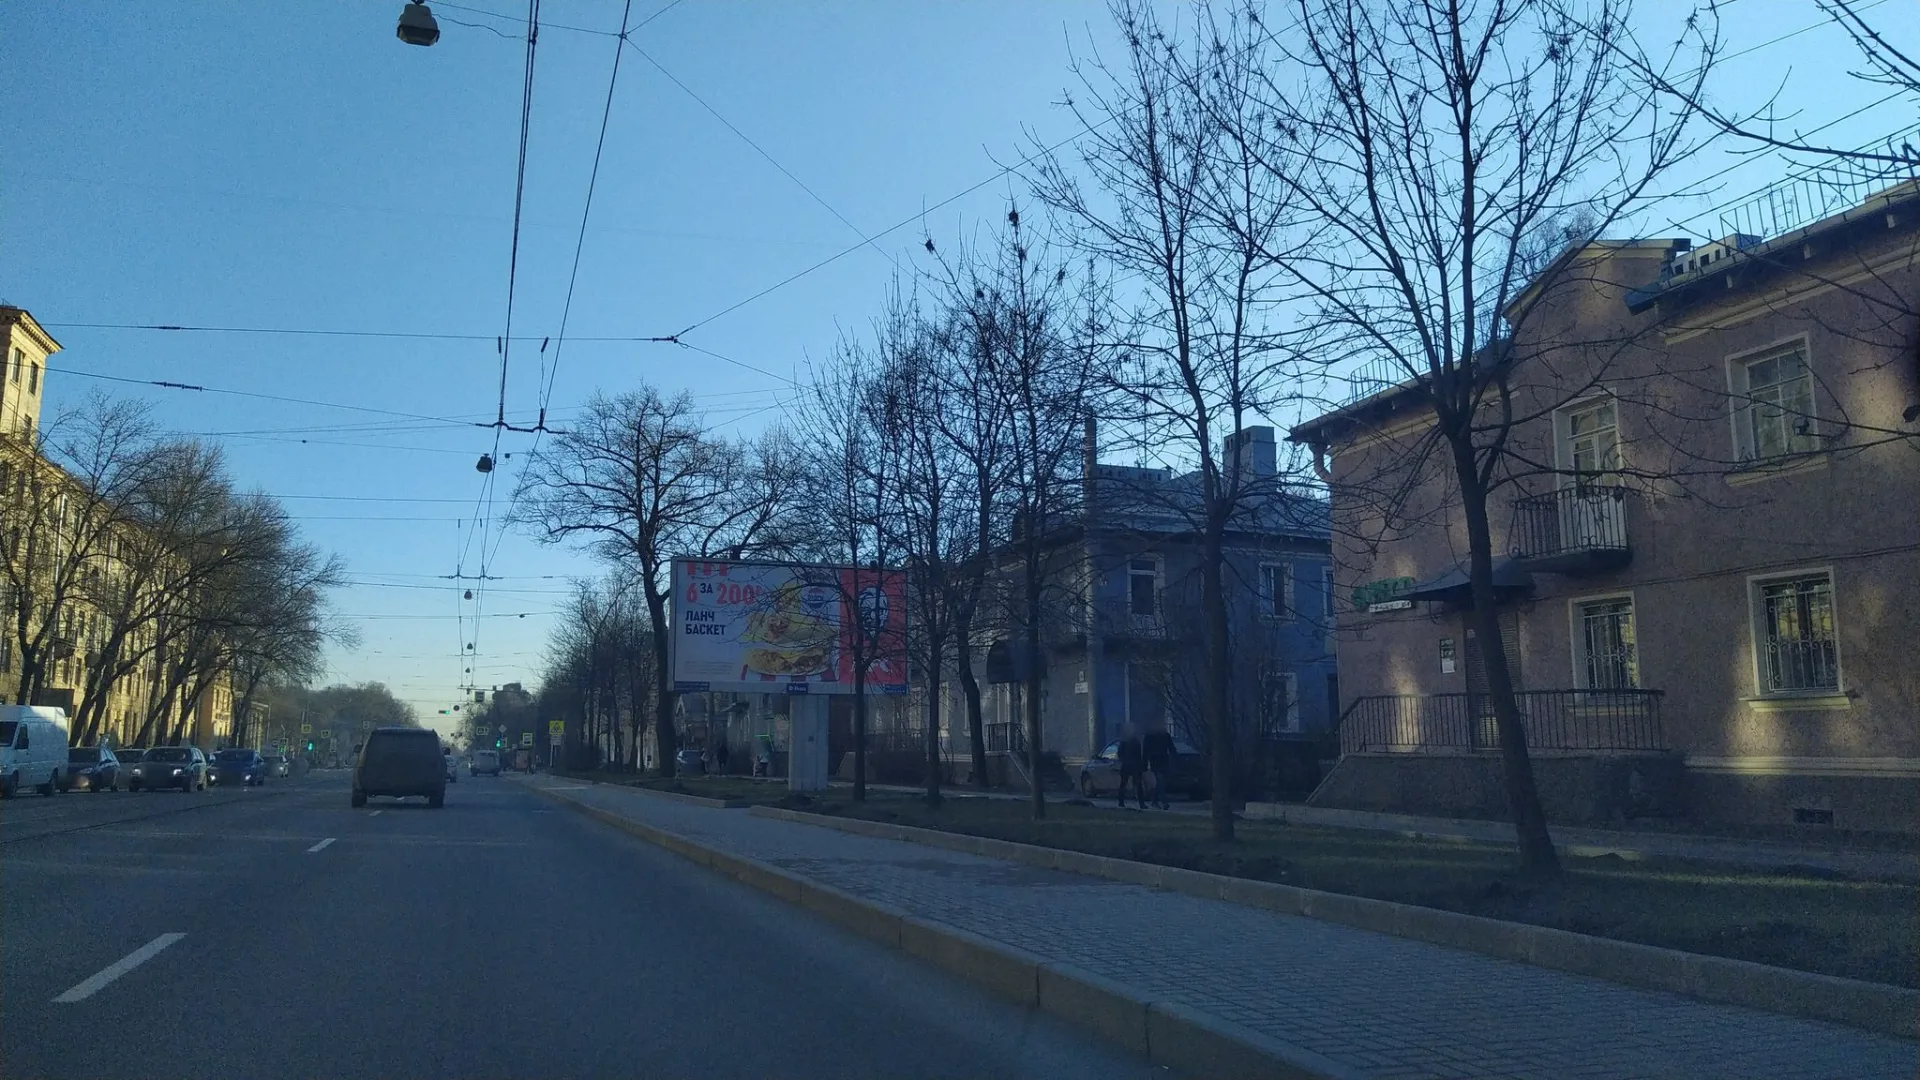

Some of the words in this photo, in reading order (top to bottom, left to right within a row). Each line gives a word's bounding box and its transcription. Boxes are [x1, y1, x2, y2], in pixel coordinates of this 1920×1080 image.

[687, 583, 697, 603] 6
[700, 583, 713, 593] ЗА
[685, 610, 715, 622] ЛАНЧ
[685, 624, 726, 636] БАСКЕТ
